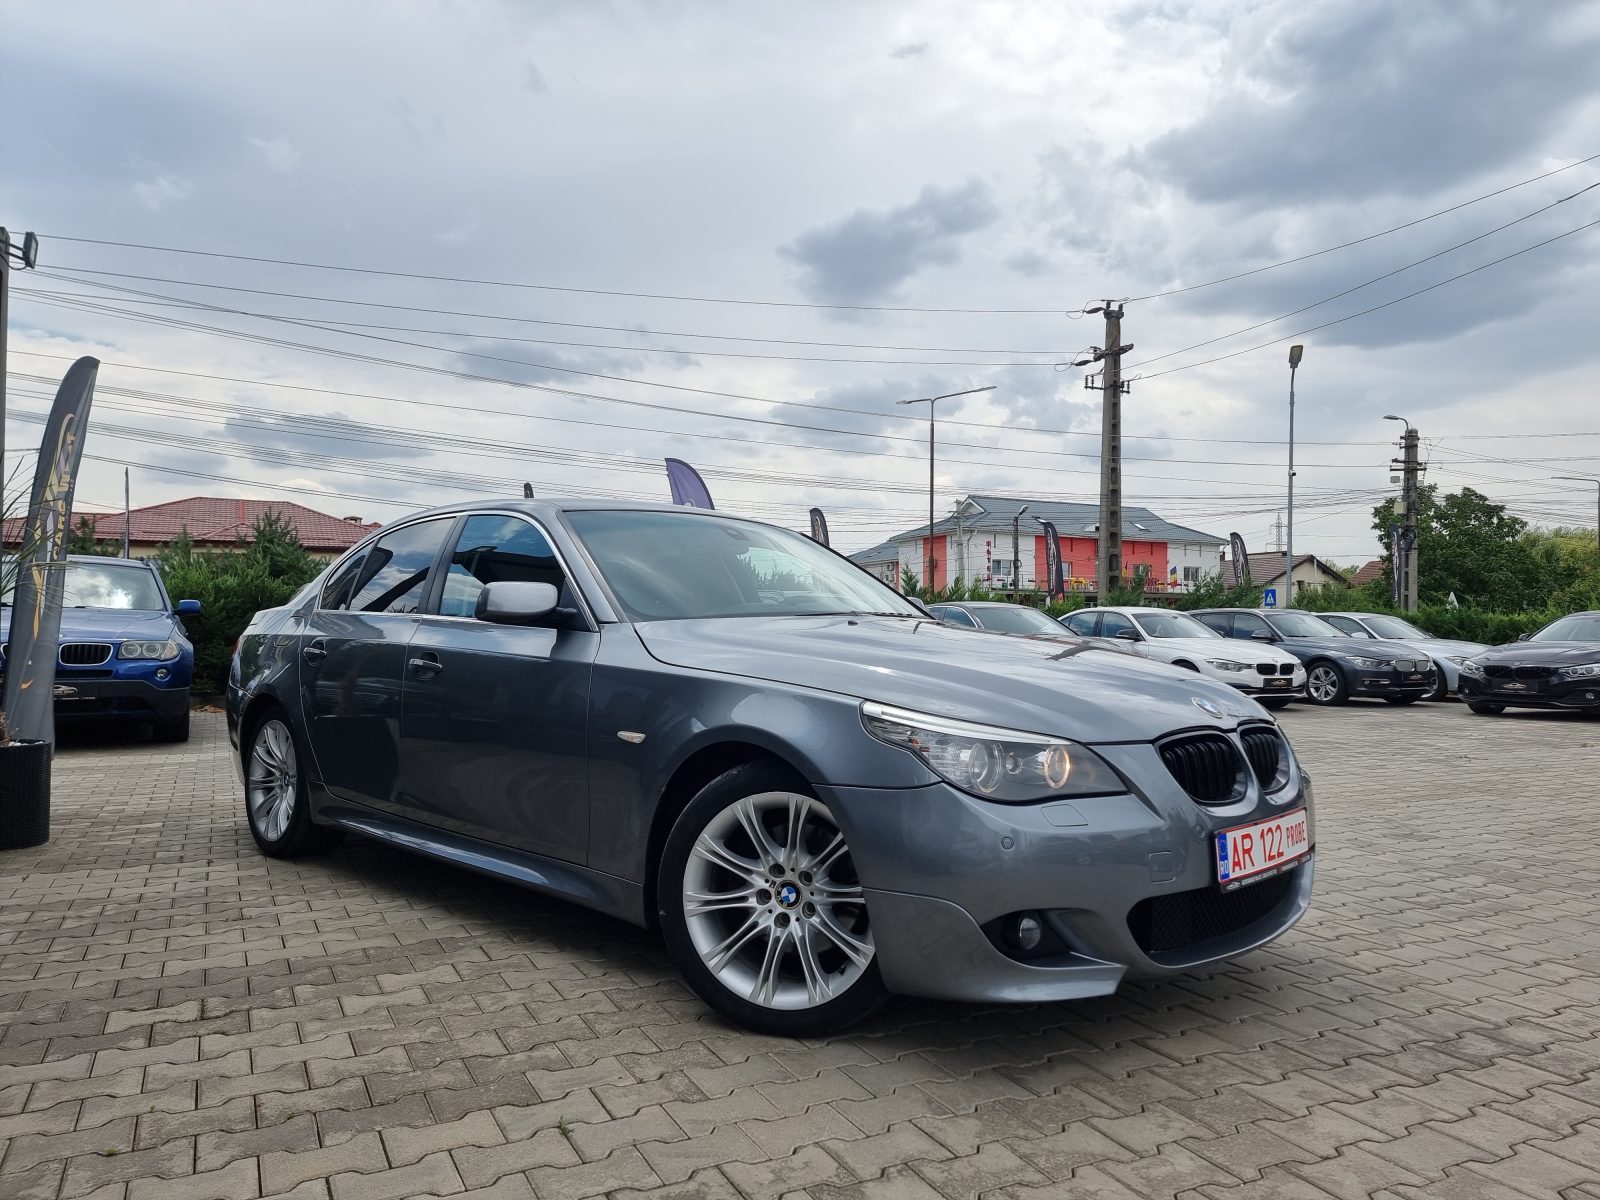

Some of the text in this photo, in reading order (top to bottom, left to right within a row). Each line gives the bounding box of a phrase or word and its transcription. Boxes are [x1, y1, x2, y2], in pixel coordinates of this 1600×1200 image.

[1232, 821, 1305, 873] AR 122 PROBE
[1220, 860, 1229, 875] RO
